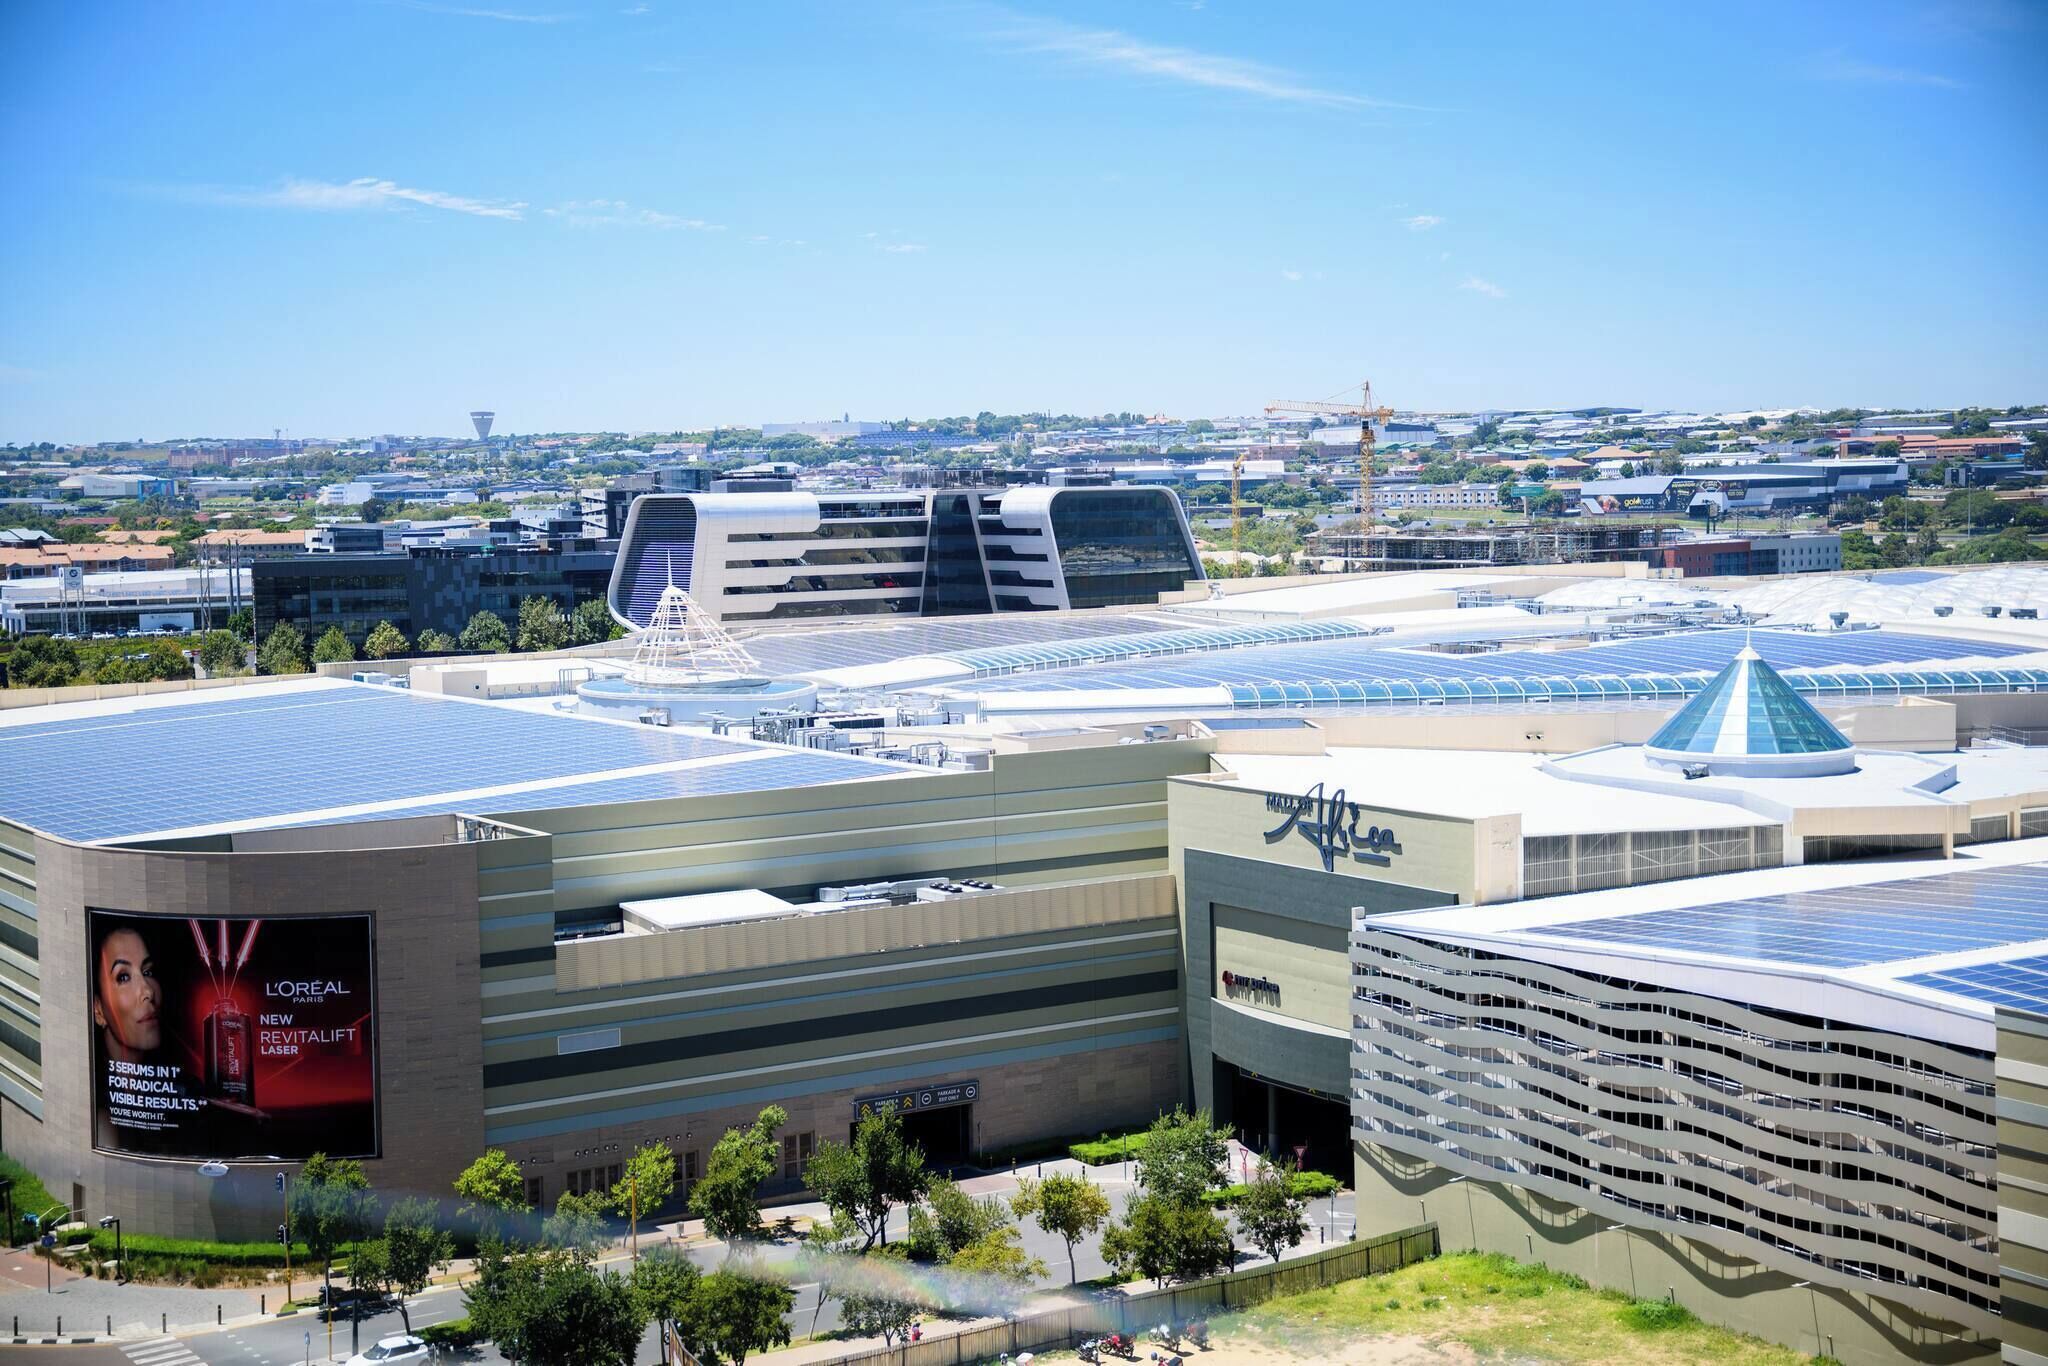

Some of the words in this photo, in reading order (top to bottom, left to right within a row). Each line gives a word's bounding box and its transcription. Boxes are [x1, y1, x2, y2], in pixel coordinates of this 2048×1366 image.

[1264, 783, 1401, 872] Africa
[266, 980, 351, 996] L'ORÉAL
[260, 1014, 293, 1025] NEW
[260, 1028, 356, 1044] REVITALIFT
[261, 1046, 298, 1054] LASER
[109, 1060, 115, 1072] 3
[116, 1063, 154, 1077] SERUMS
[157, 1067, 169, 1078] IN
[109, 1076, 129, 1089] FOR
[130, 1079, 177, 1094] RADICAL
[110, 1092, 144, 1107] VISIBLE
[110, 1107, 131, 1117] YOU'RE
[132, 1110, 156, 1120] WORTH
